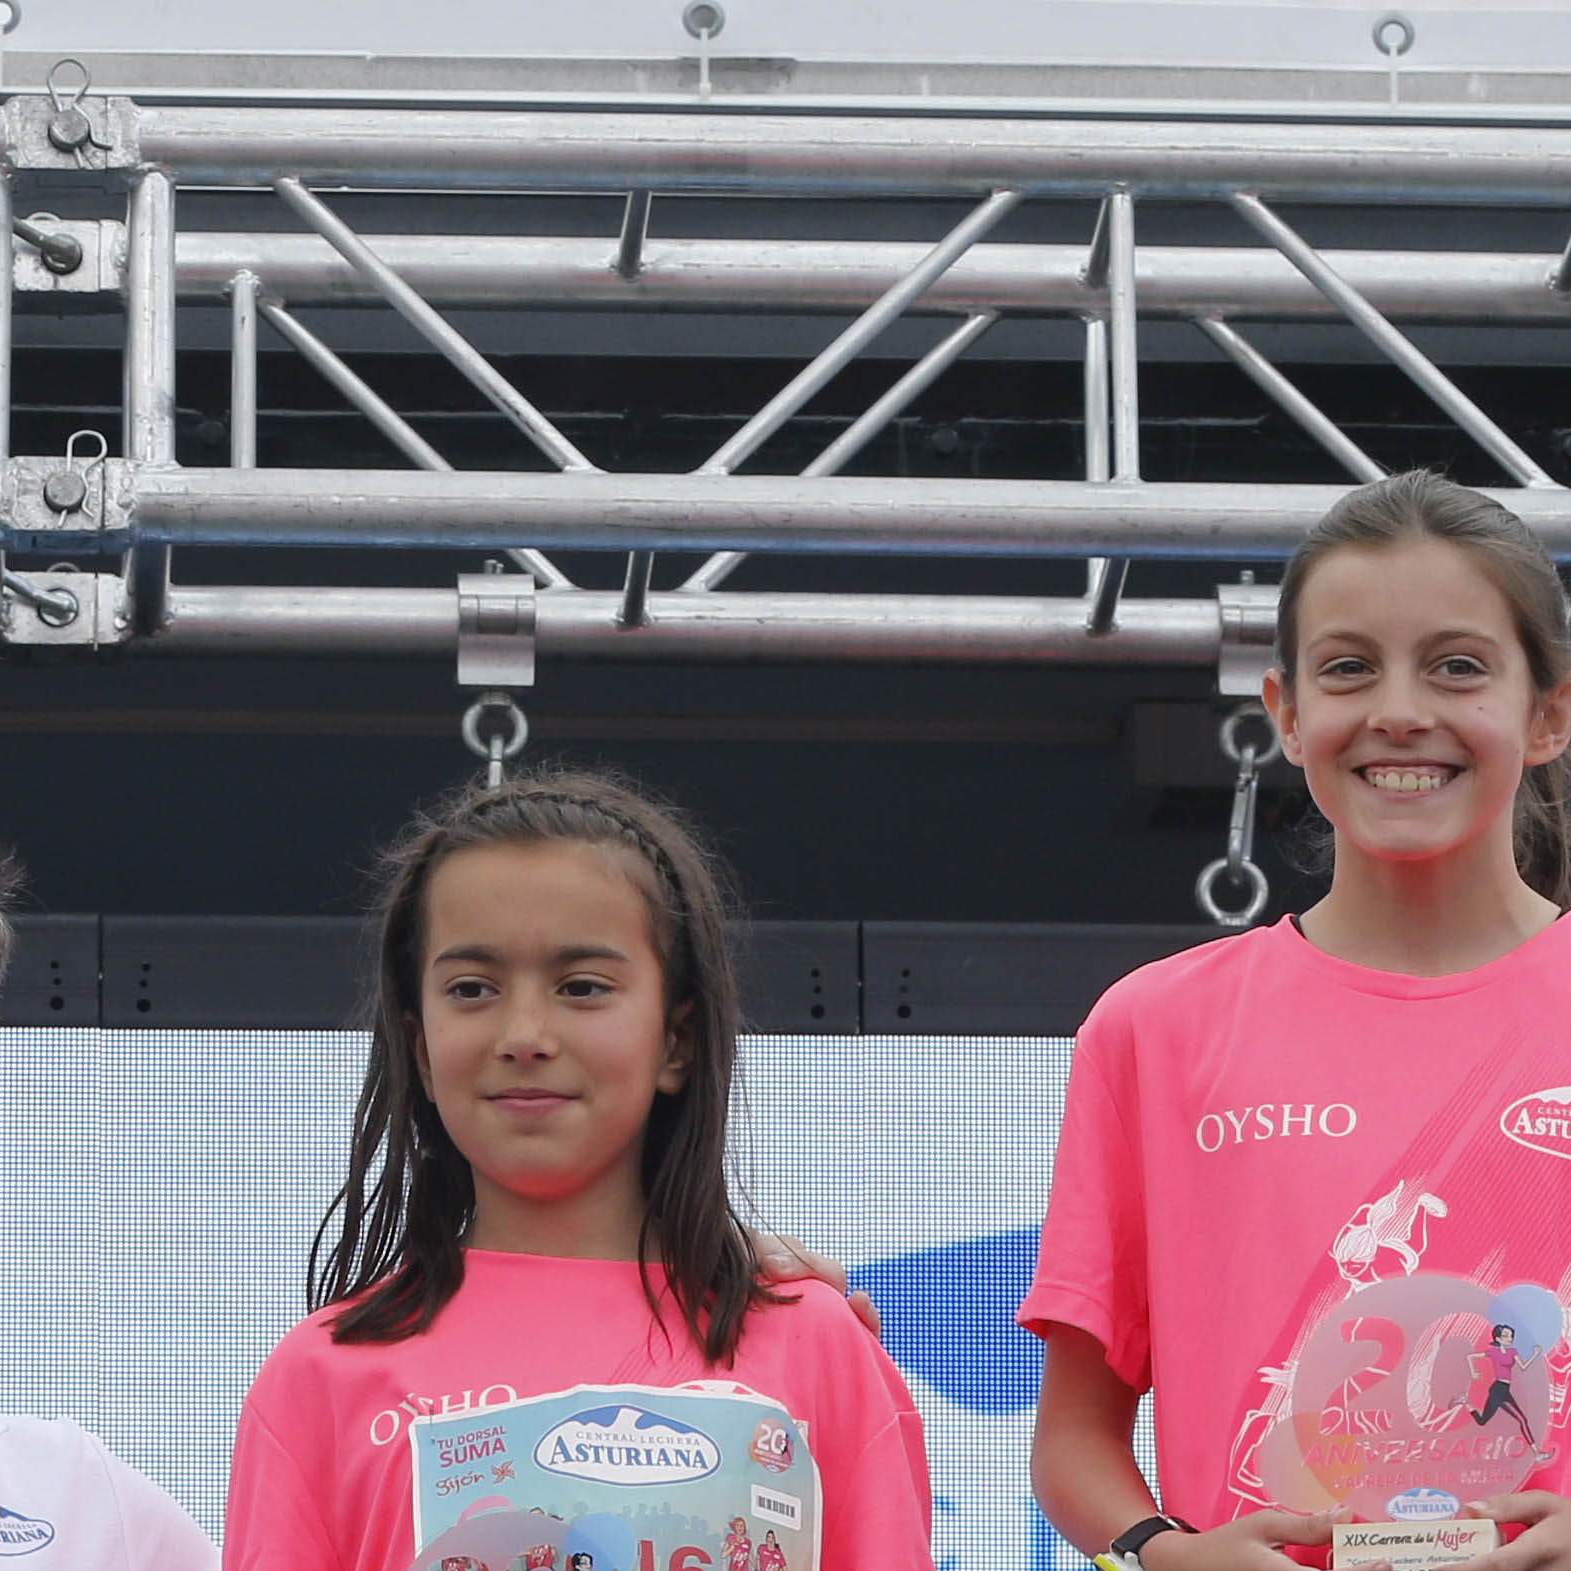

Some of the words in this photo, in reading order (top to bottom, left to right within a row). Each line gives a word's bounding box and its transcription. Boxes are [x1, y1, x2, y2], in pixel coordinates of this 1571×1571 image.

[1196, 1103, 1358, 1153] OYSHO
[437, 1438, 453, 1450] TU
[457, 1425, 506, 1445] DORSAL
[576, 1430, 636, 1442] CENTRAL
[639, 1430, 701, 1446] LECHERA
[439, 1438, 506, 1468] SUMA
[549, 1435, 709, 1469] ASTURIANA
[435, 1471, 485, 1496] gijón
[1391, 1501, 1455, 1514] ASTURIANA
[1434, 1527, 1477, 1551] Mujer
